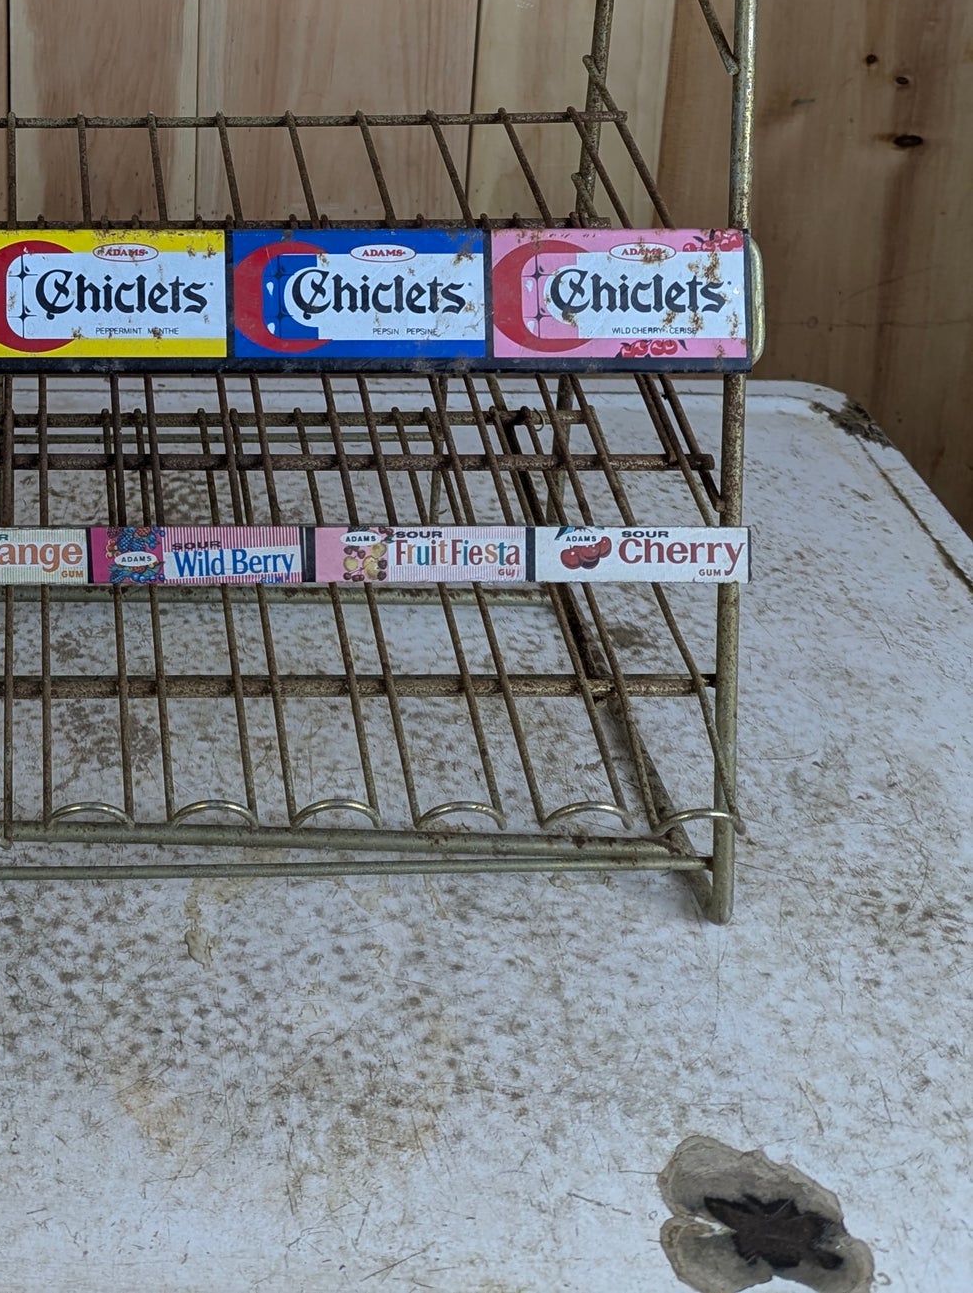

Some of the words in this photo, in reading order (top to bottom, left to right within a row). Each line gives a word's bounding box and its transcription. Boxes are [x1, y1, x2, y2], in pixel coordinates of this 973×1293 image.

[104, 248, 146, 258] ADAMS
[361, 249, 403, 258] ADAMS
[35, 269, 208, 321] Chiclets
[292, 269, 466, 321] Chiclets
[550, 269, 727, 321] Chiclets
[95, 327, 142, 336] PEPPERMINT
[372, 327, 400, 336] PEPSIN
[406, 327, 438, 336] PEPSINE
[612, 327, 631, 335] WILD
[632, 327, 662, 335] CHERRY
[345, 535, 377, 543] ADAMS
[395, 531, 443, 539] SOUR
[171, 540, 222, 550] SOUR
[395, 539, 448, 566] Fruit
[451, 539, 521, 566] Fiesta
[618, 538, 746, 576] Cherry
[121, 555, 152, 563] ADAMS
[173, 549, 226, 577] Wild
[231, 548, 295, 581] Berry
[61, 570, 84, 578] GUM
